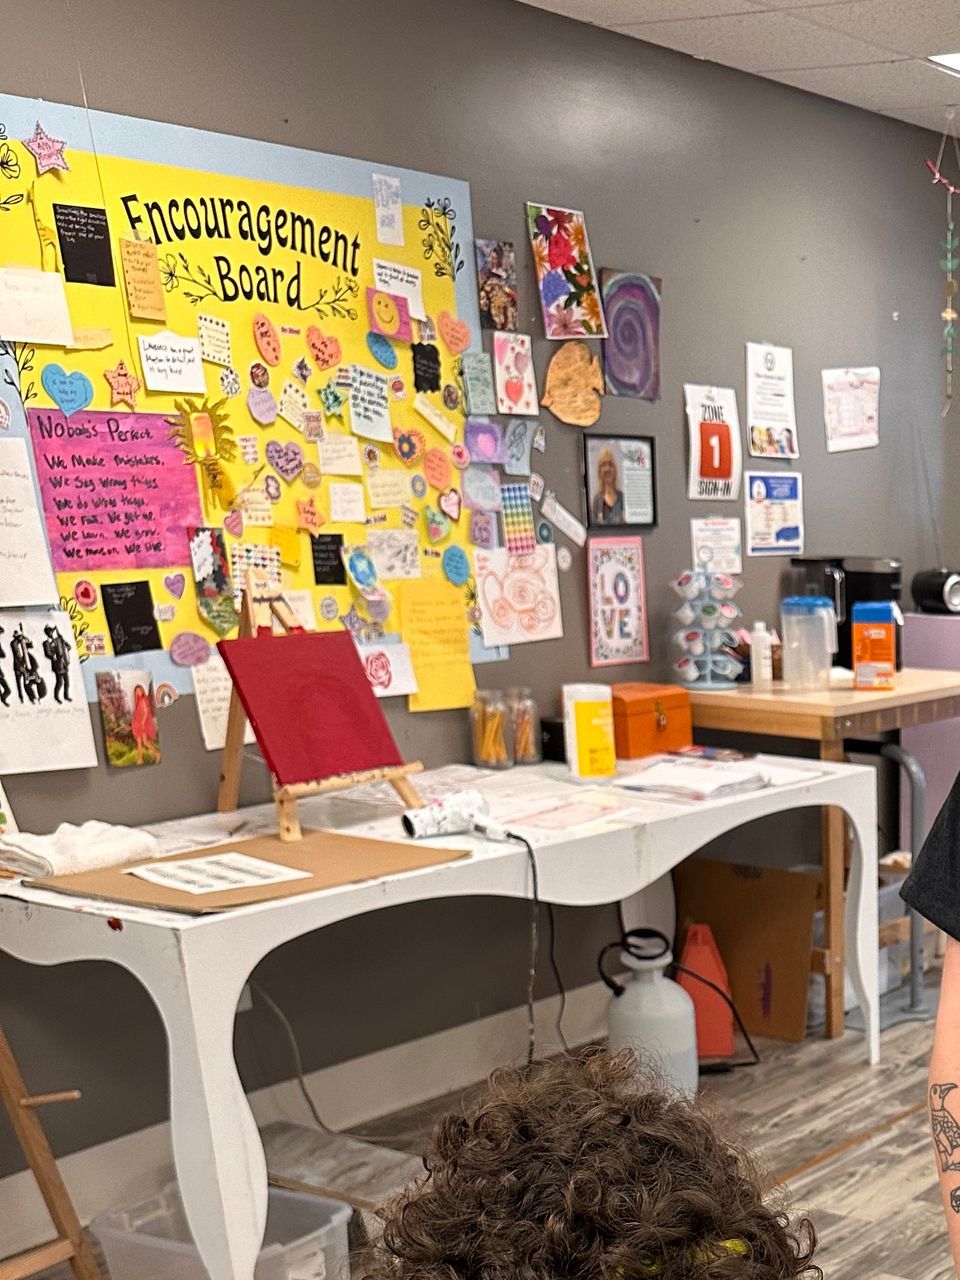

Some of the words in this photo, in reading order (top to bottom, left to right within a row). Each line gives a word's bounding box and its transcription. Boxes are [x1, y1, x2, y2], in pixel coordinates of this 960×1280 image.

[120, 194, 361, 277] Encouragement
[214, 255, 302, 310] Board
[701, 403, 726, 423] ZONE
[709, 435, 720, 469] 1
[44, 454, 68, 470] We
[49, 475, 71, 489] We
[697, 480, 732, 497] SIGN-IN
[53, 497, 73, 511] We
[57, 514, 77, 527] We
[61, 530, 78, 542] We
[63, 547, 84, 559] We
[124, 542, 142, 554] We
